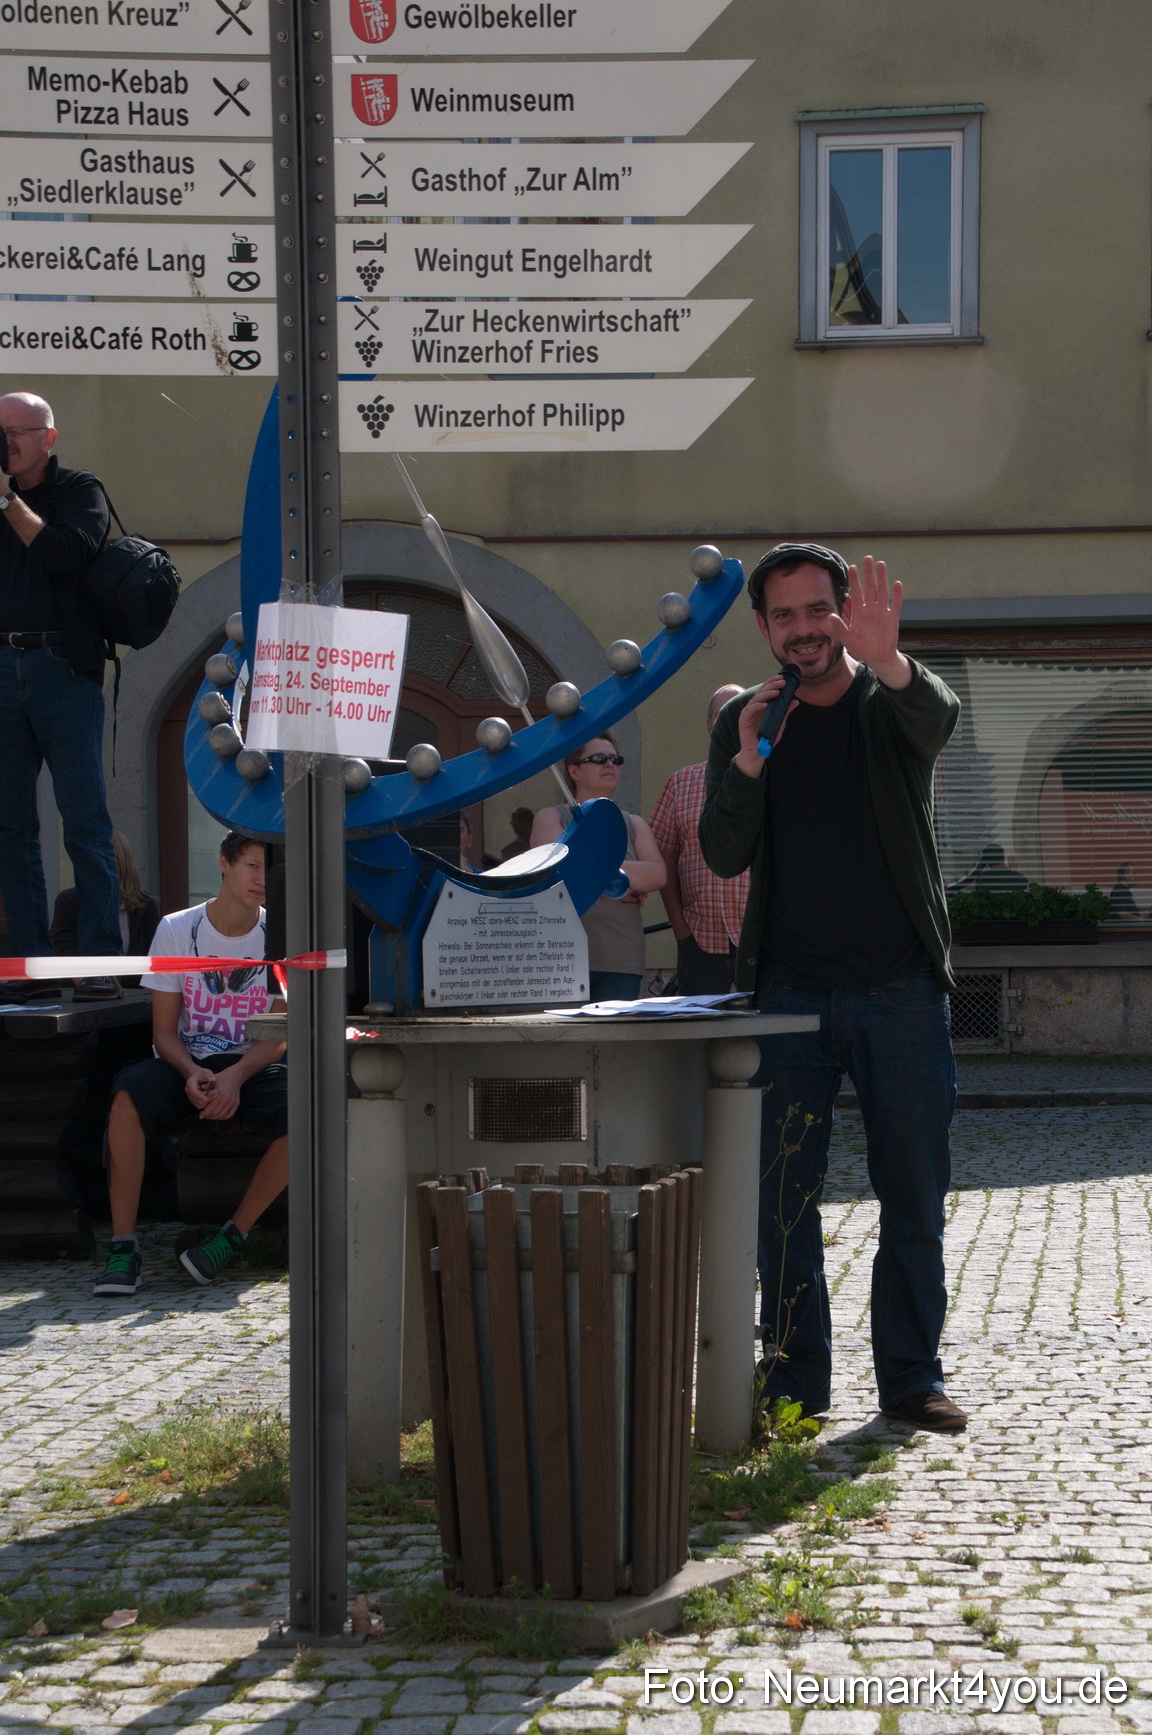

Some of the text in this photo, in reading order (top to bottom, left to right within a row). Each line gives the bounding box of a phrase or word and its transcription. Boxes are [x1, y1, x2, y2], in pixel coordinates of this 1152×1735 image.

[1, 0, 98, 24] oldenen
[405, 3, 577, 29] Gewölbekeller
[28, 66, 188, 94] Memo-Kebab
[411, 88, 574, 112] Weinmuseum
[57, 99, 189, 126] Pizza Haus
[81, 148, 194, 174] Gasthaus
[412, 167, 507, 191] Gasthof
[148, 248, 205, 279] Lang
[415, 248, 651, 278] Weingut Engelhardt
[152, 327, 206, 350] Roth
[412, 340, 598, 363] Winzerhof Fries
[415, 403, 624, 432] Winzerhof Philipp
[256, 639, 395, 671] Marktplatz gesperrt
[253, 671, 390, 697] Samstag, 24. September
[250, 700, 260, 714] von
[261, 696, 282, 713] 11.30
[286, 697, 312, 715] Uhr
[326, 700, 363, 721] 14.00
[367, 704, 392, 723] Uhr
[471, 917, 486, 925] MESZ
[522, 917, 537, 925] untere
[539, 916, 567, 924] Ziffernreihe
[439, 940, 575, 951] Hinweis: Bei Sonnenschein erkennt der Betrachter
[479, 929, 487, 937] mit
[490, 929, 537, 938] Jahreszeitausgleich
[439, 955, 447, 963] die
[449, 956, 468, 964] genaue
[526, 953, 537, 961] dem
[539, 952, 564, 960] Zifferblatt
[439, 967, 458, 976] breiten
[461, 966, 499, 975] Schattenstrich
[506, 965, 520, 974] linker
[523, 965, 534, 973] oder
[536, 965, 554, 973] rechter
[557, 964, 569, 972] Rand
[481, 991, 495, 999] linker
[497, 990, 508, 999] oder
[510, 990, 528, 998] rechter
[530, 989, 543, 997] Rand
[483, 979, 491, 987] der
[493, 978, 524, 987] zutreffenden
[526, 977, 551, 985] Jahreszeit
